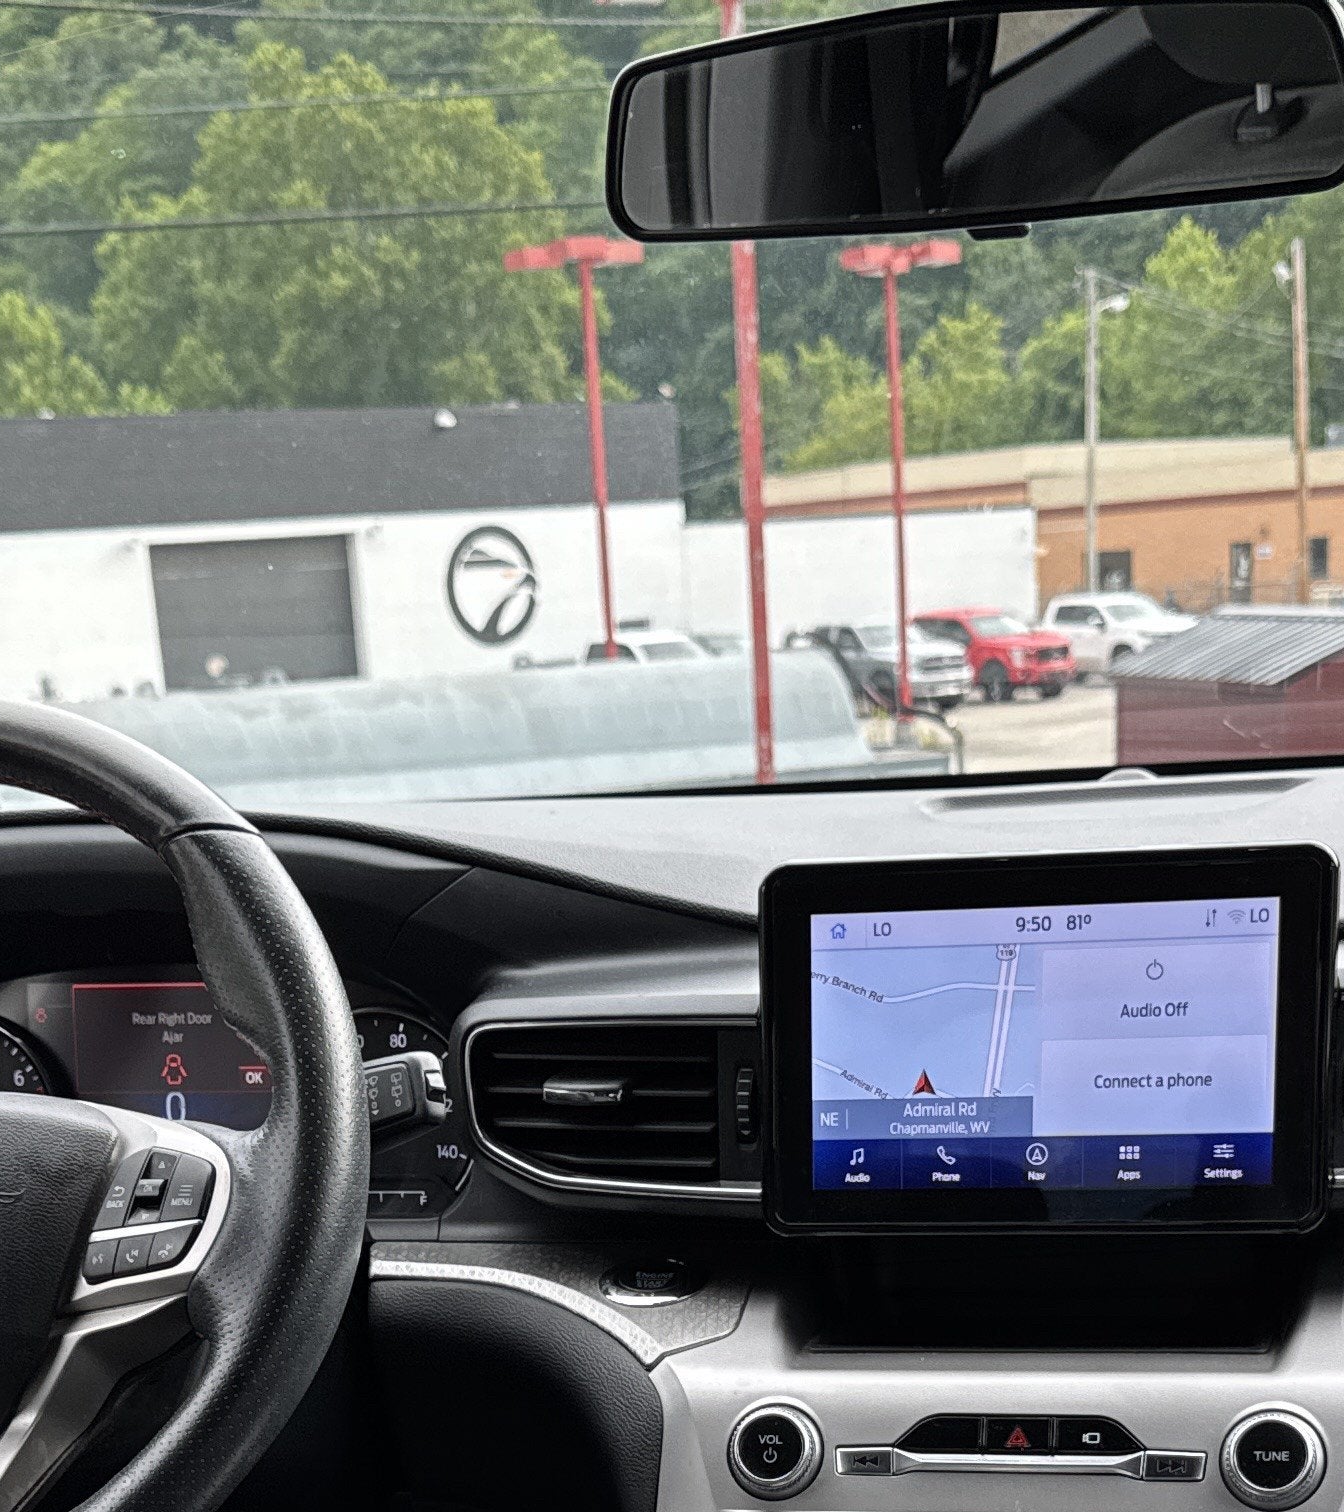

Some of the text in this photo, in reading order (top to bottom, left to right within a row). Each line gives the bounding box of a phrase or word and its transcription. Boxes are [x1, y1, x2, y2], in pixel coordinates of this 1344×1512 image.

[1250, 908, 1270, 923] LO
[873, 922, 892, 937] LO
[1015, 916, 1052, 932] 9:50
[832, 976, 867, 997] Branch
[869, 991, 884, 1003] Rd
[1120, 1002, 1189, 1018] Audio Off
[131, 1012, 212, 1027] Rear Right Door
[162, 1031, 184, 1044] Ajar
[389, 1033, 407, 1048] 80
[13, 1069, 25, 1087] 6
[245, 1072, 263, 1084] OK
[839, 1069, 889, 1099] Admiral Rd
[1094, 1072, 1213, 1090] Connect a phone
[903, 1101, 977, 1118] Admiral Rd
[820, 1112, 839, 1127] NE
[889, 1121, 990, 1137] Chapmanville, WV
[437, 1145, 458, 1159] 140
[845, 1172, 870, 1183] Audio
[932, 1171, 960, 1182] Phone
[1028, 1171, 1046, 1181] Nav
[1117, 1170, 1141, 1182] Apps
[1204, 1168, 1243, 1180] Settings
[170, 1198, 193, 1206] MENU
[419, 1194, 428, 1206] F
[758, 1434, 783, 1445] VOL
[1253, 1451, 1290, 1462] TUNE
